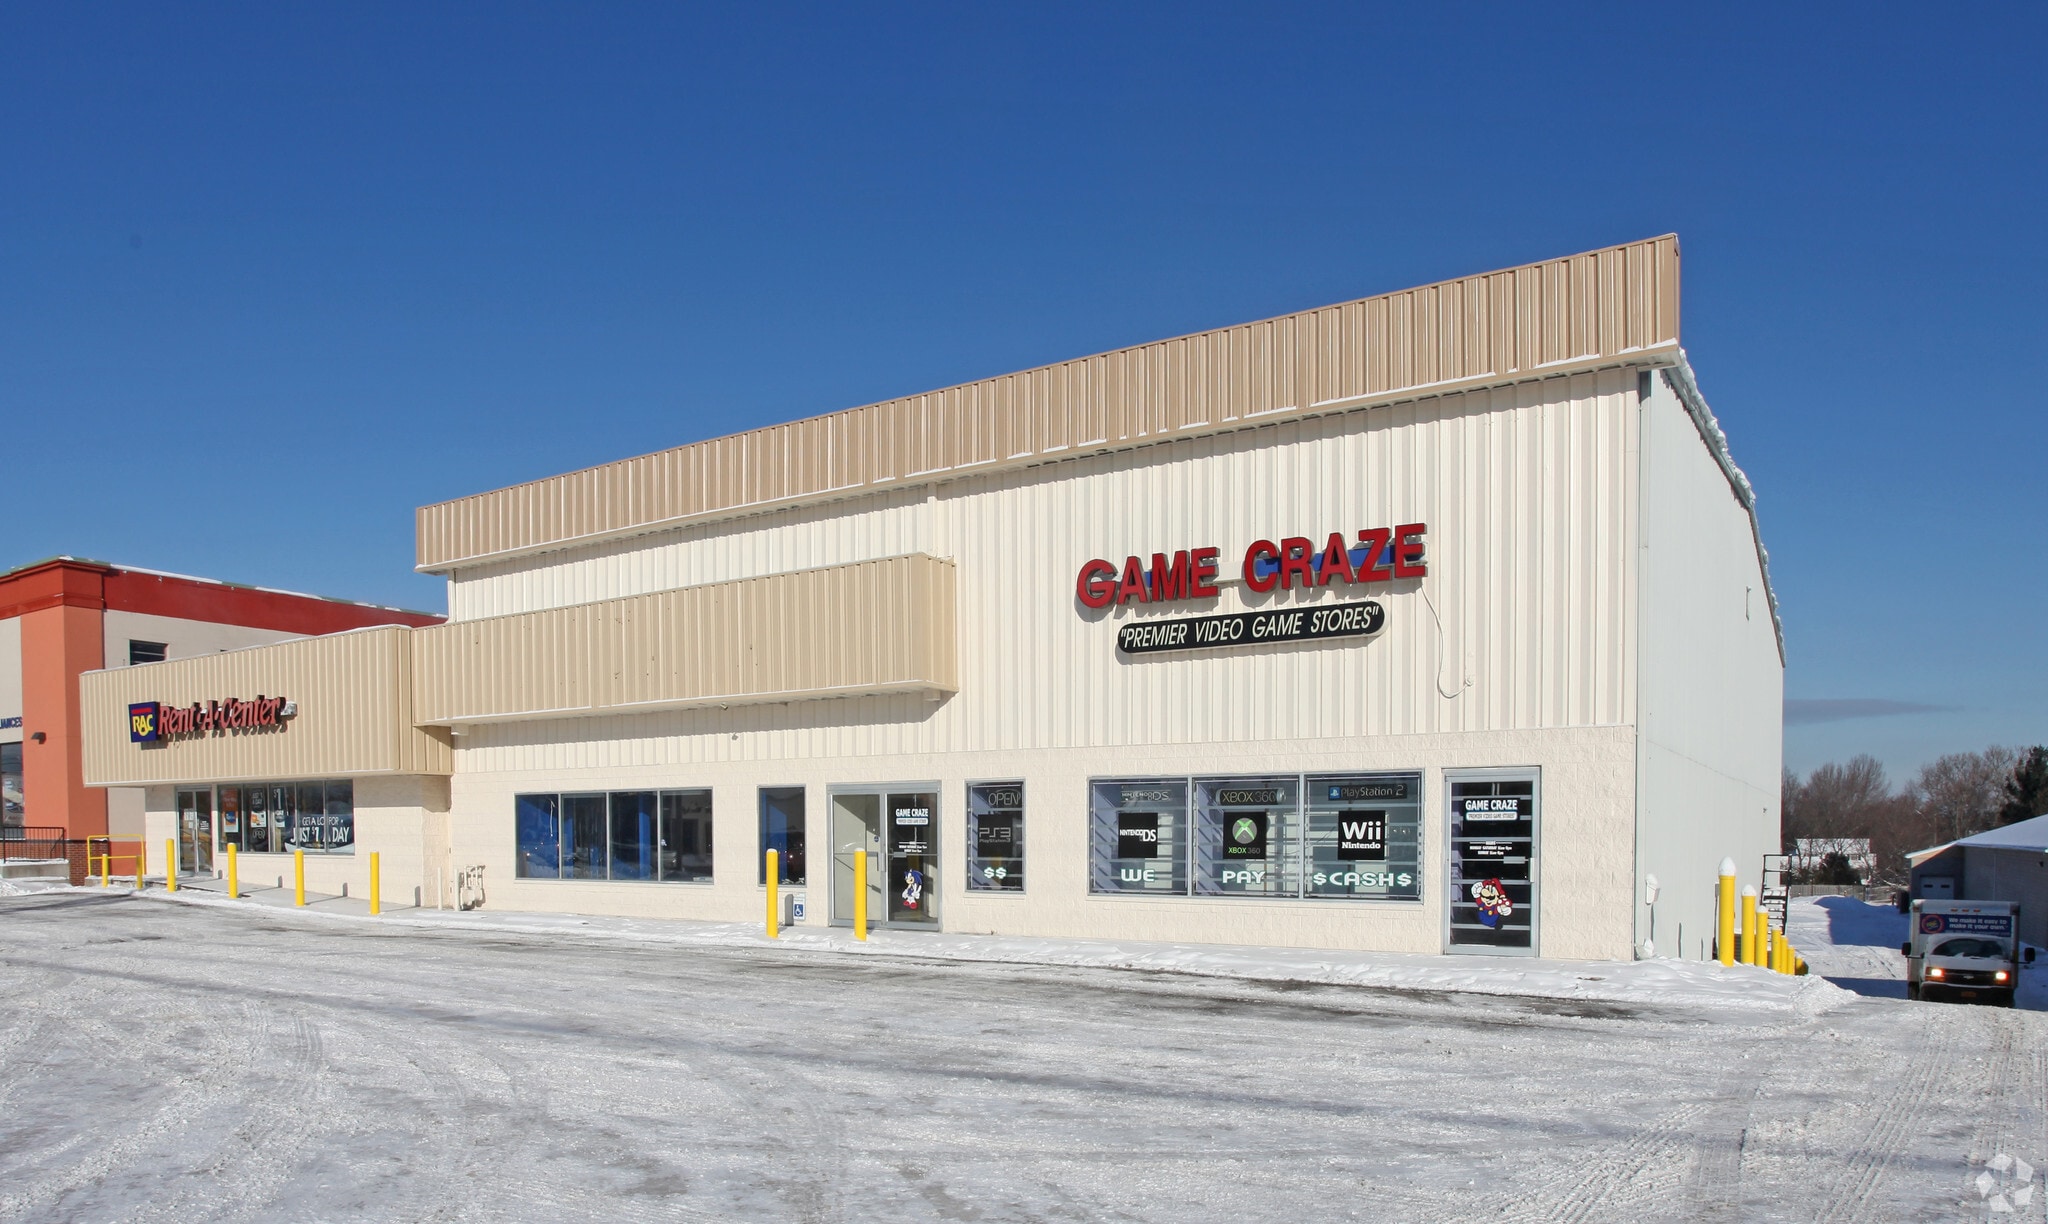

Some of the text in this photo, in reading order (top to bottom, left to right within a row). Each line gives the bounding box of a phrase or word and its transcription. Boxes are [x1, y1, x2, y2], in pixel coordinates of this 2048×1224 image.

[1076, 523, 1428, 608] GAME CRAZE
[1120, 605, 1380, 648] "PREMIER VIDEO GAME STORES"
[132, 714, 154, 736] RAC
[1222, 790, 1276, 803] XBOX 360
[1341, 784, 1404, 798] PlayStation 2
[988, 792, 1019, 806] OPEN
[1465, 799, 1518, 811] GAME CRAZE
[895, 808, 929, 818] GAME CRAZE
[302, 816, 339, 826] GET A LO FOR
[311, 826, 320, 842] $1
[332, 826, 350, 843] DAY
[979, 827, 1012, 838] PS3
[1142, 829, 1157, 842] DS
[1342, 820, 1382, 841] Wii
[1228, 846, 1247, 854] XBOX
[1341, 841, 1382, 850] Nintendo
[1121, 868, 1155, 882] WE
[1222, 870, 1266, 884] PAY
